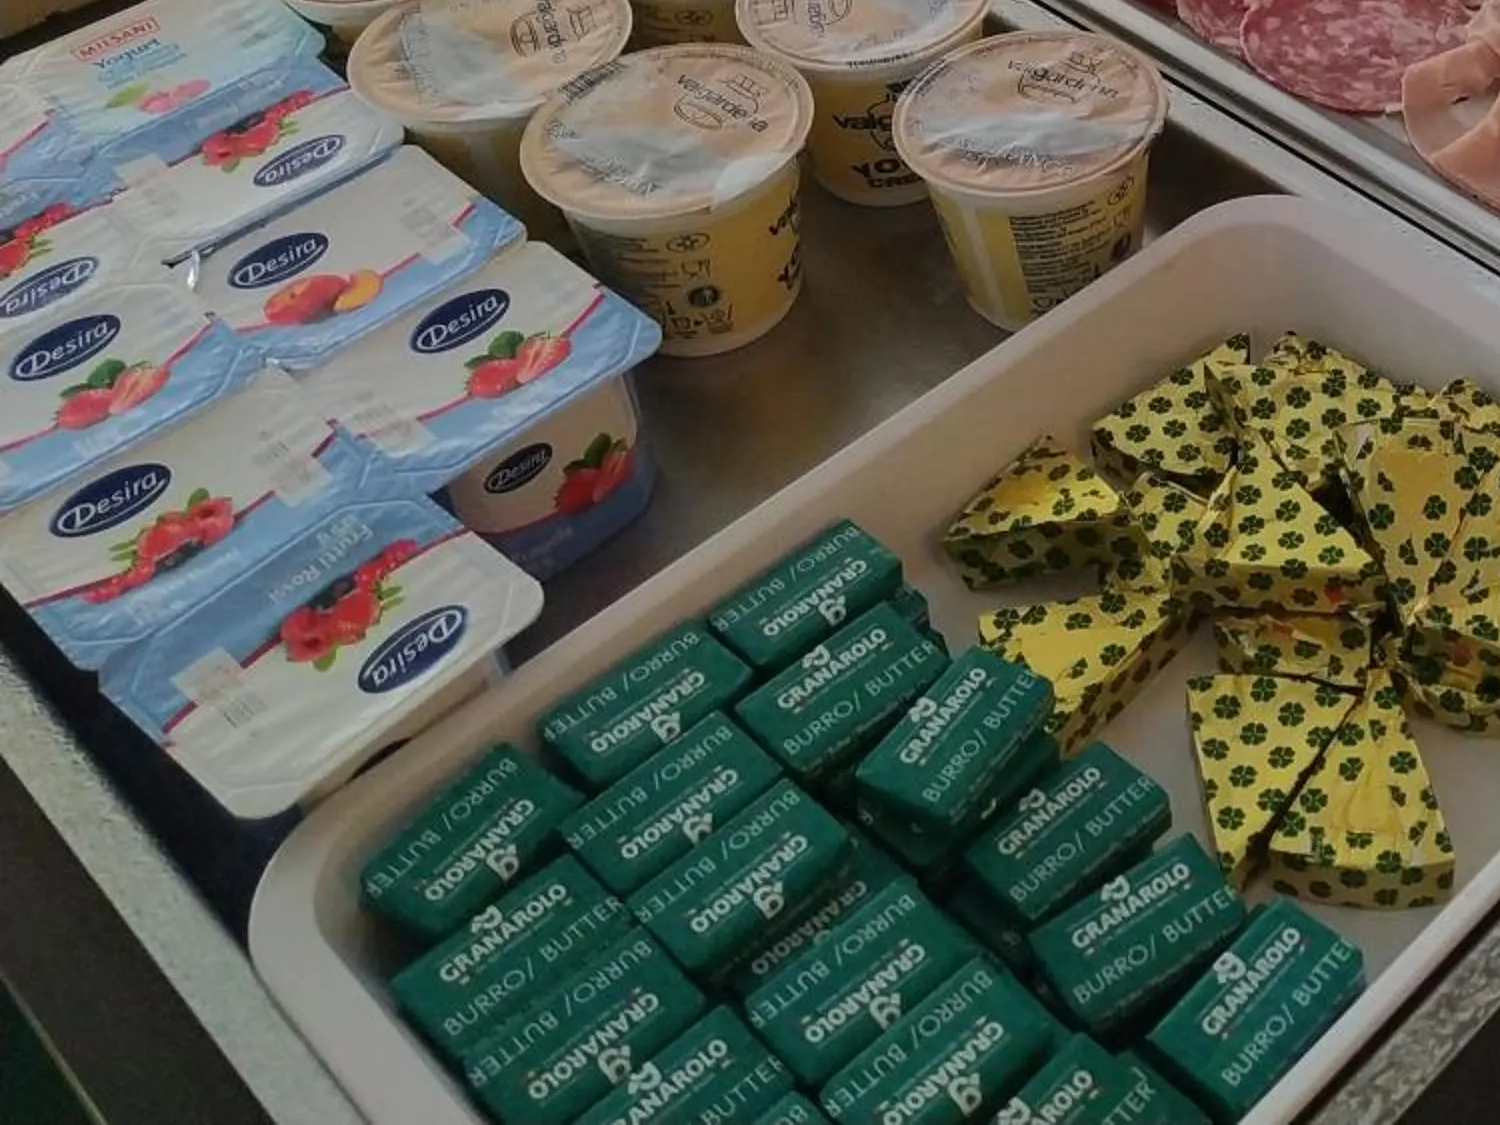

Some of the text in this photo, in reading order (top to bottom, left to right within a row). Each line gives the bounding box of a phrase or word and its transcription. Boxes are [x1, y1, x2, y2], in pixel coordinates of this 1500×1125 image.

[262, 137, 342, 183] Desira
[5, 259, 94, 315] Desira
[234, 238, 321, 286] Desira
[16, 322, 112, 376] Desira
[417, 295, 501, 351] Desira
[57, 472, 162, 534] Desira
[487, 449, 549, 491] Desira
[763, 559, 867, 636] GRANAROLO
[369, 608, 464, 687] Desira
[777, 628, 887, 710] GRANAROLO
[865, 639, 938, 697] BUTTER
[591, 670, 705, 753] GRANAROLO
[900, 667, 987, 765] GRANAROLO
[424, 798, 535, 901] GRANAROLO
[566, 786, 648, 851] BUTTER
[621, 768, 738, 859] GRANAROLO
[998, 767, 1101, 856] GRANAROLO
[634, 856, 717, 924] BUTTER
[690, 834, 808, 933] GRANAROLO
[1072, 862, 1191, 950] GRANAROLO
[440, 884, 567, 982] GRANAROLO
[539, 895, 625, 963] BUTTER
[804, 943, 925, 1043] GRANAROLO
[1202, 926, 1302, 1037] GRANAROLO
[467, 1011, 559, 1088] BUTTER
[528, 992, 660, 1100] GRANAROLO
[823, 1042, 907, 1119] BUTTER
[883, 1020, 1005, 1125] GRANAROLO
